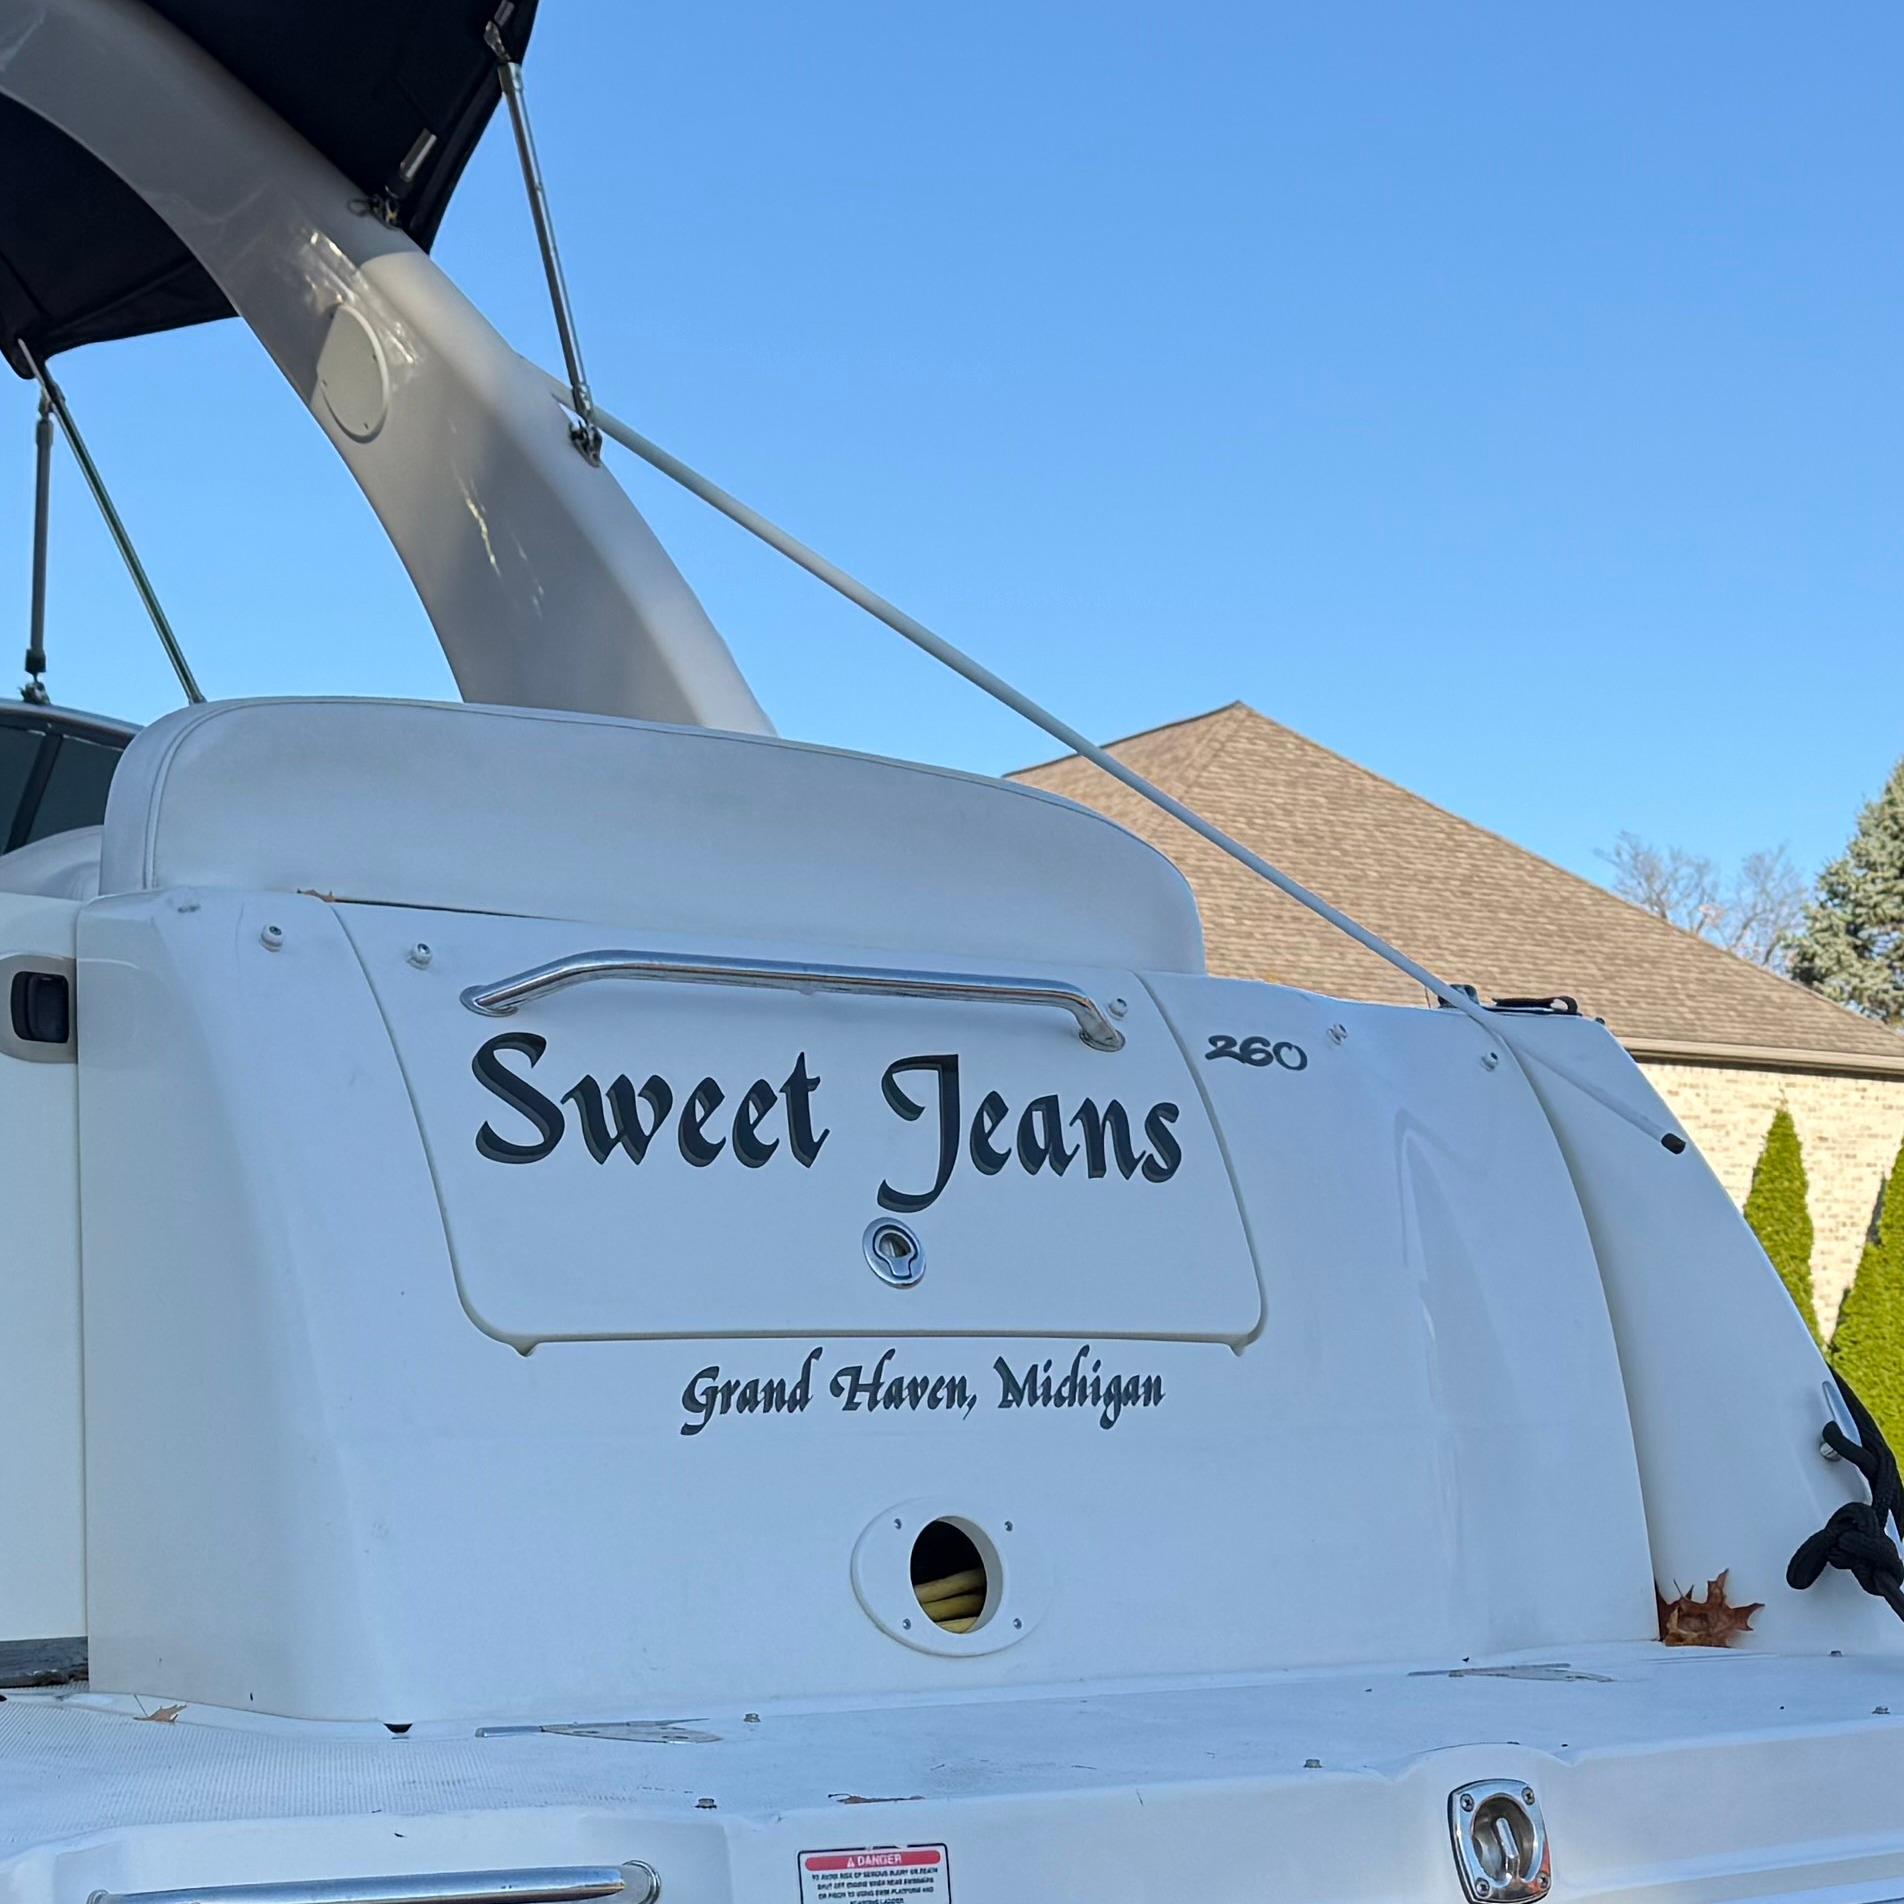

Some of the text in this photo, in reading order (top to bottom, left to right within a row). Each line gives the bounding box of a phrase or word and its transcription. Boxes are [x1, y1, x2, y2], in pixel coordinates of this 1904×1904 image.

[1204, 1034, 1308, 1071] 260
[472, 1032, 1182, 1213] Sweet Jeans
[681, 1345, 1164, 1435] Grand Haven, Michigan
[857, 1854, 902, 1865] DANGER
